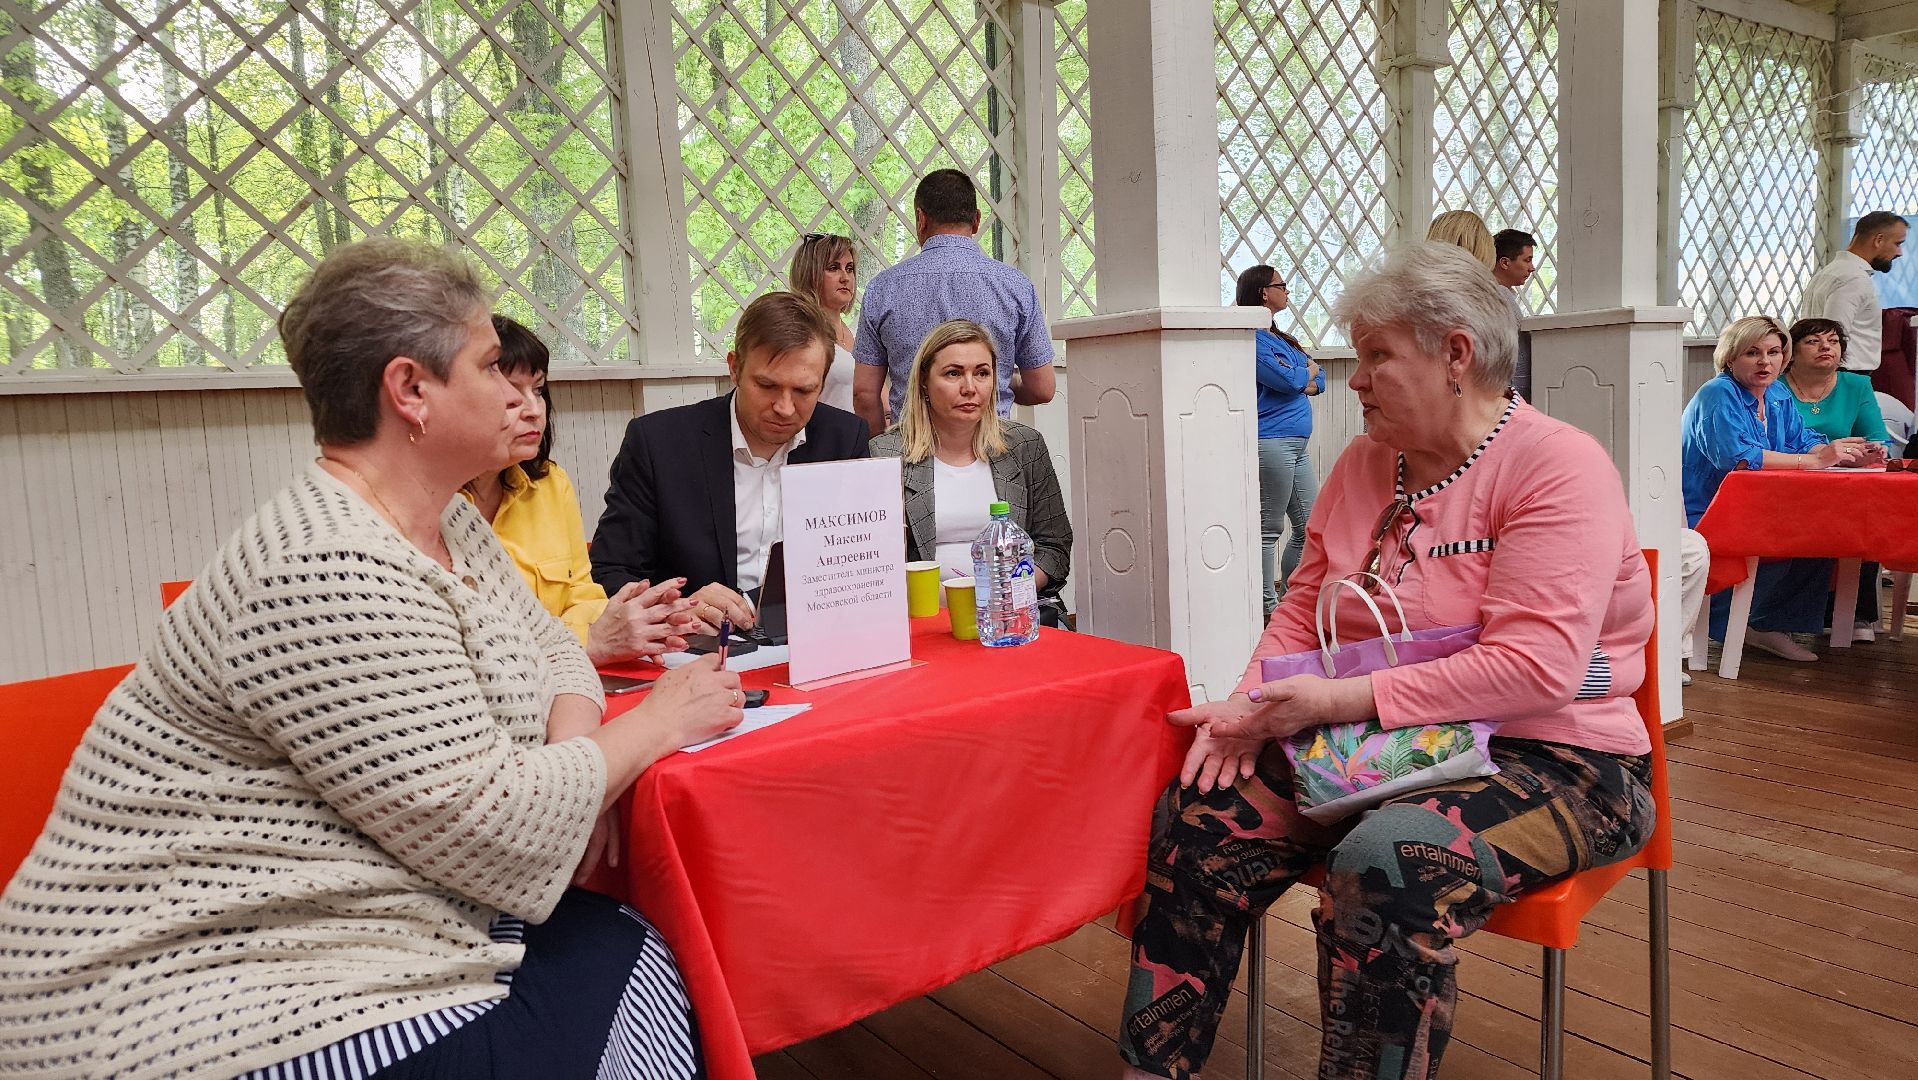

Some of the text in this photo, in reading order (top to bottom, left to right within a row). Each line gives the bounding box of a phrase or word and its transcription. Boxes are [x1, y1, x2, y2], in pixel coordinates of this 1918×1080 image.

[805, 509, 887, 531] МАКСИМОВ
[823, 533, 871, 548] Максим
[816, 550, 880, 568] Андреевич
[801, 563, 894, 585] Заместитель министра
[814, 579, 885, 598] здравоохранения
[807, 590, 892, 612] Московской области
